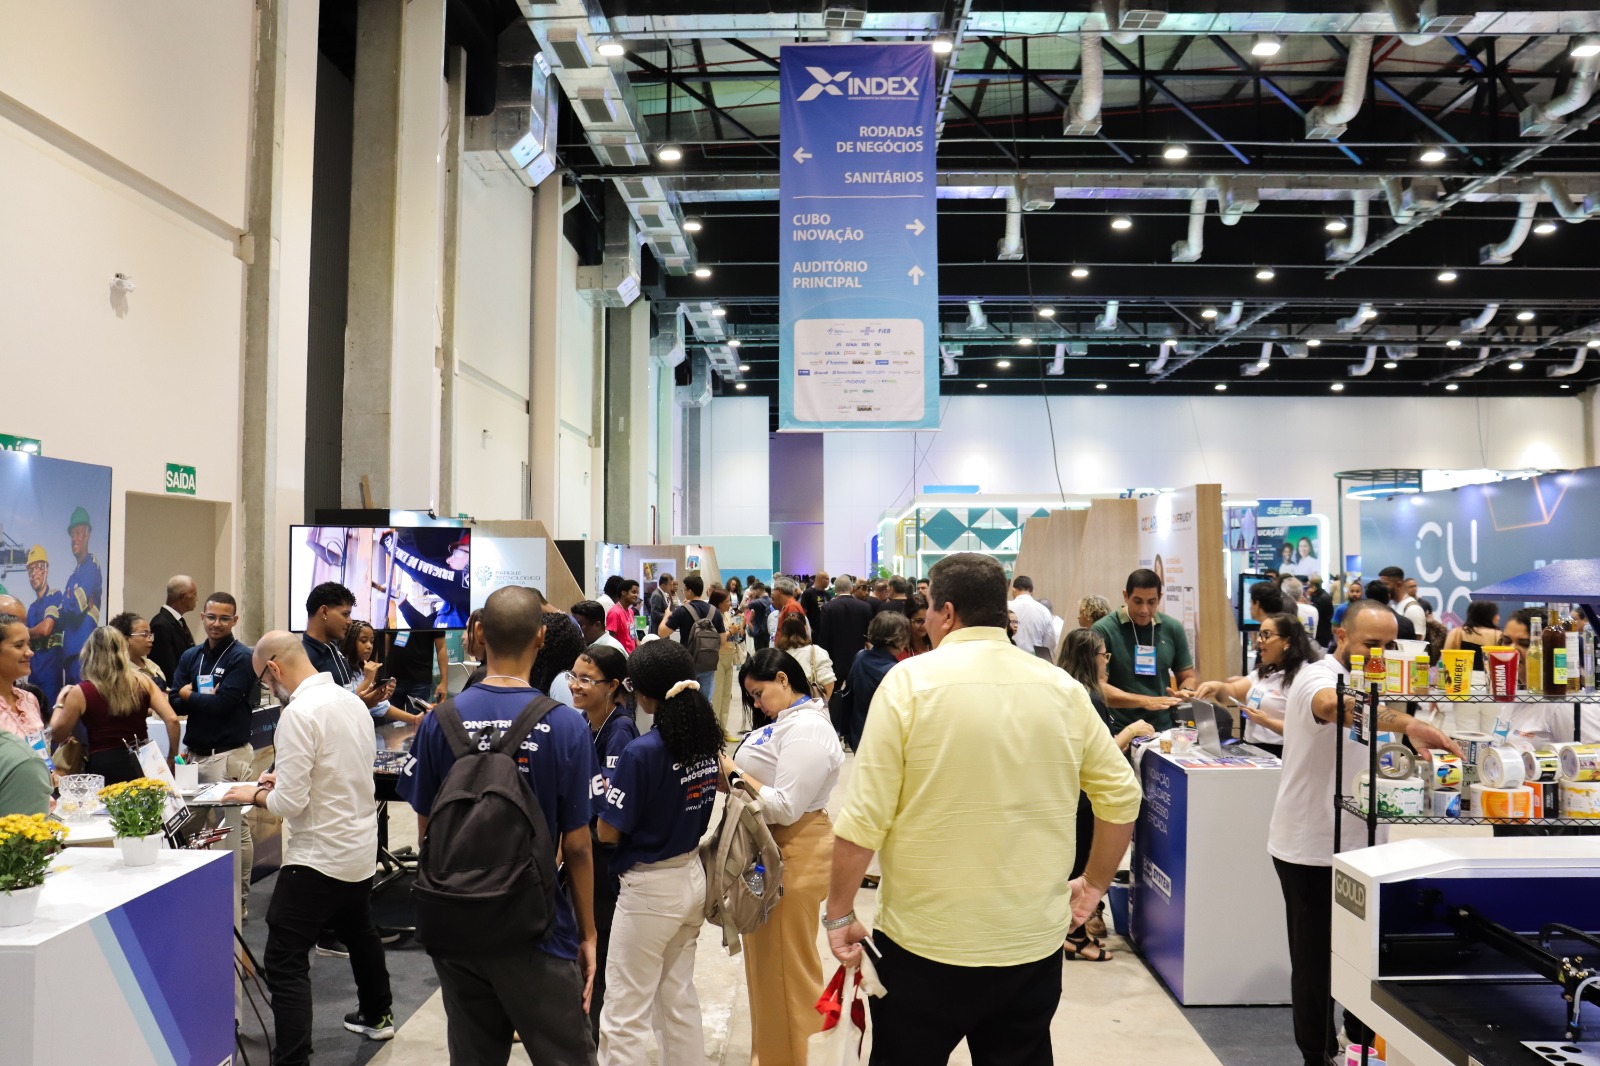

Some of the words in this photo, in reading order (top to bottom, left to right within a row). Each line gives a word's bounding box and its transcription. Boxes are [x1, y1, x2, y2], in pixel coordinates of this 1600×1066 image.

[848, 76, 919, 96] INDEX
[859, 126, 923, 137] RODADAS
[836, 141, 854, 153] DE
[856, 139, 924, 153] NEGÓCIOS
[844, 170, 924, 184] SANITÁRIOS
[793, 213, 831, 226] CUBO
[793, 227, 864, 243] INOVAÇÃO
[793, 259, 868, 273] AUDITÓRIO
[793, 276, 862, 288] PRINCIPAL
[166, 468, 196, 490] SAÍDA
[1267, 506, 1305, 515] SEBRAE
[1257, 527, 1285, 538] UCAÇÃO
[1453, 658, 1463, 693] VAIDEBET
[1335, 873, 1365, 907] GOULD
